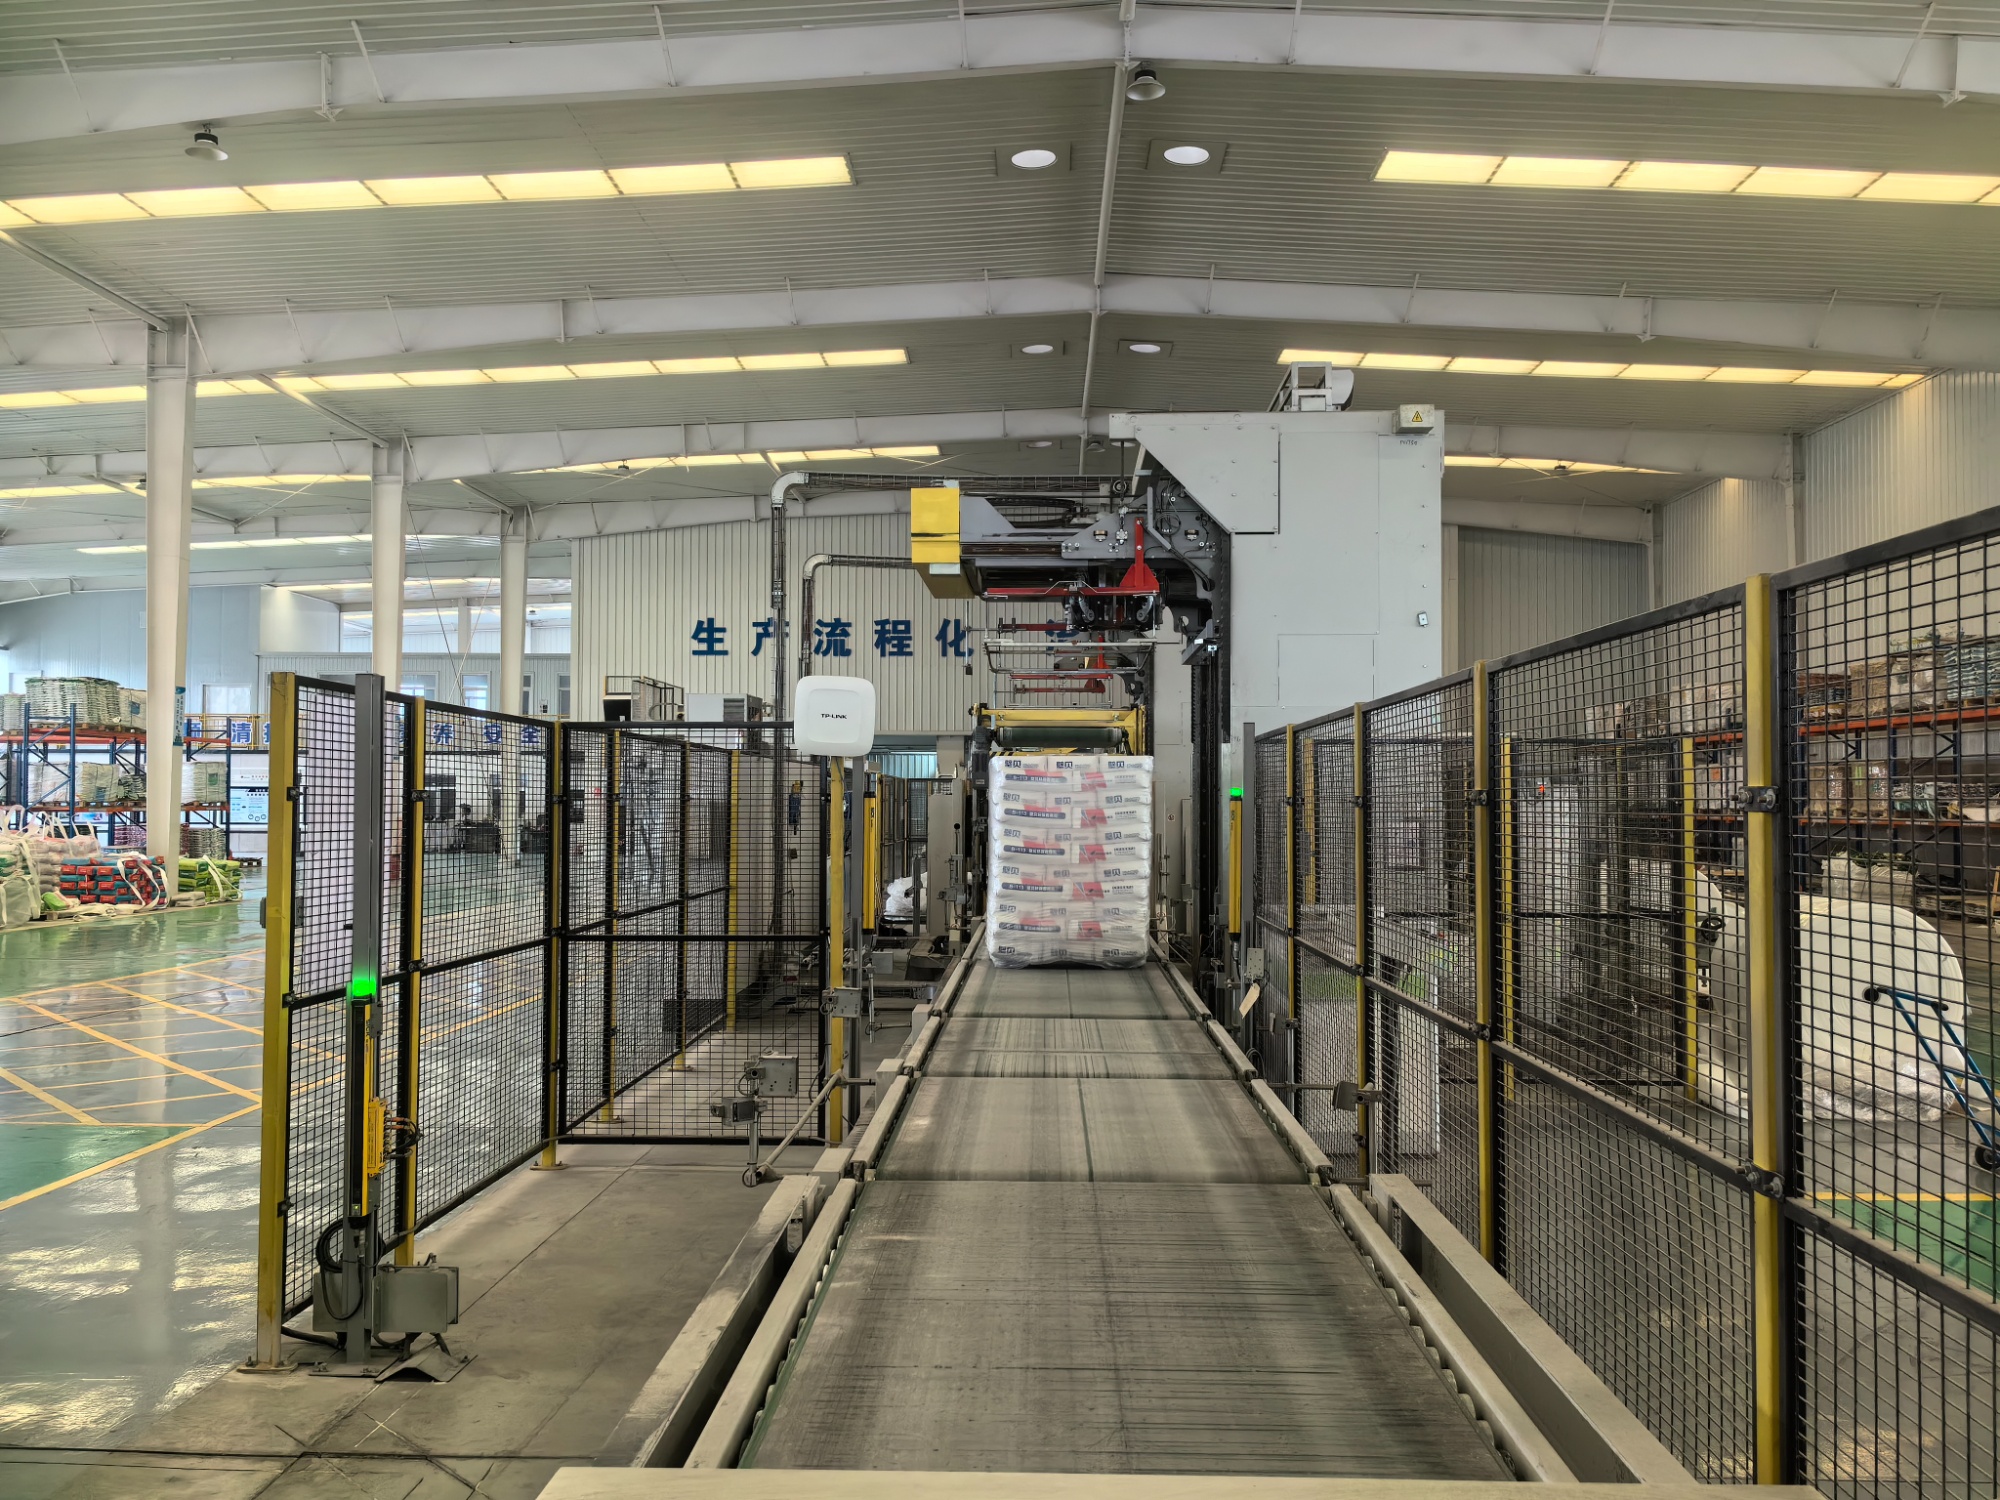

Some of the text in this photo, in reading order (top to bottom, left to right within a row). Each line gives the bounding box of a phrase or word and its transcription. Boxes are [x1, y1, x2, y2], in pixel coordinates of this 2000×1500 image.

[691, 617, 974, 658] 生产流程化
